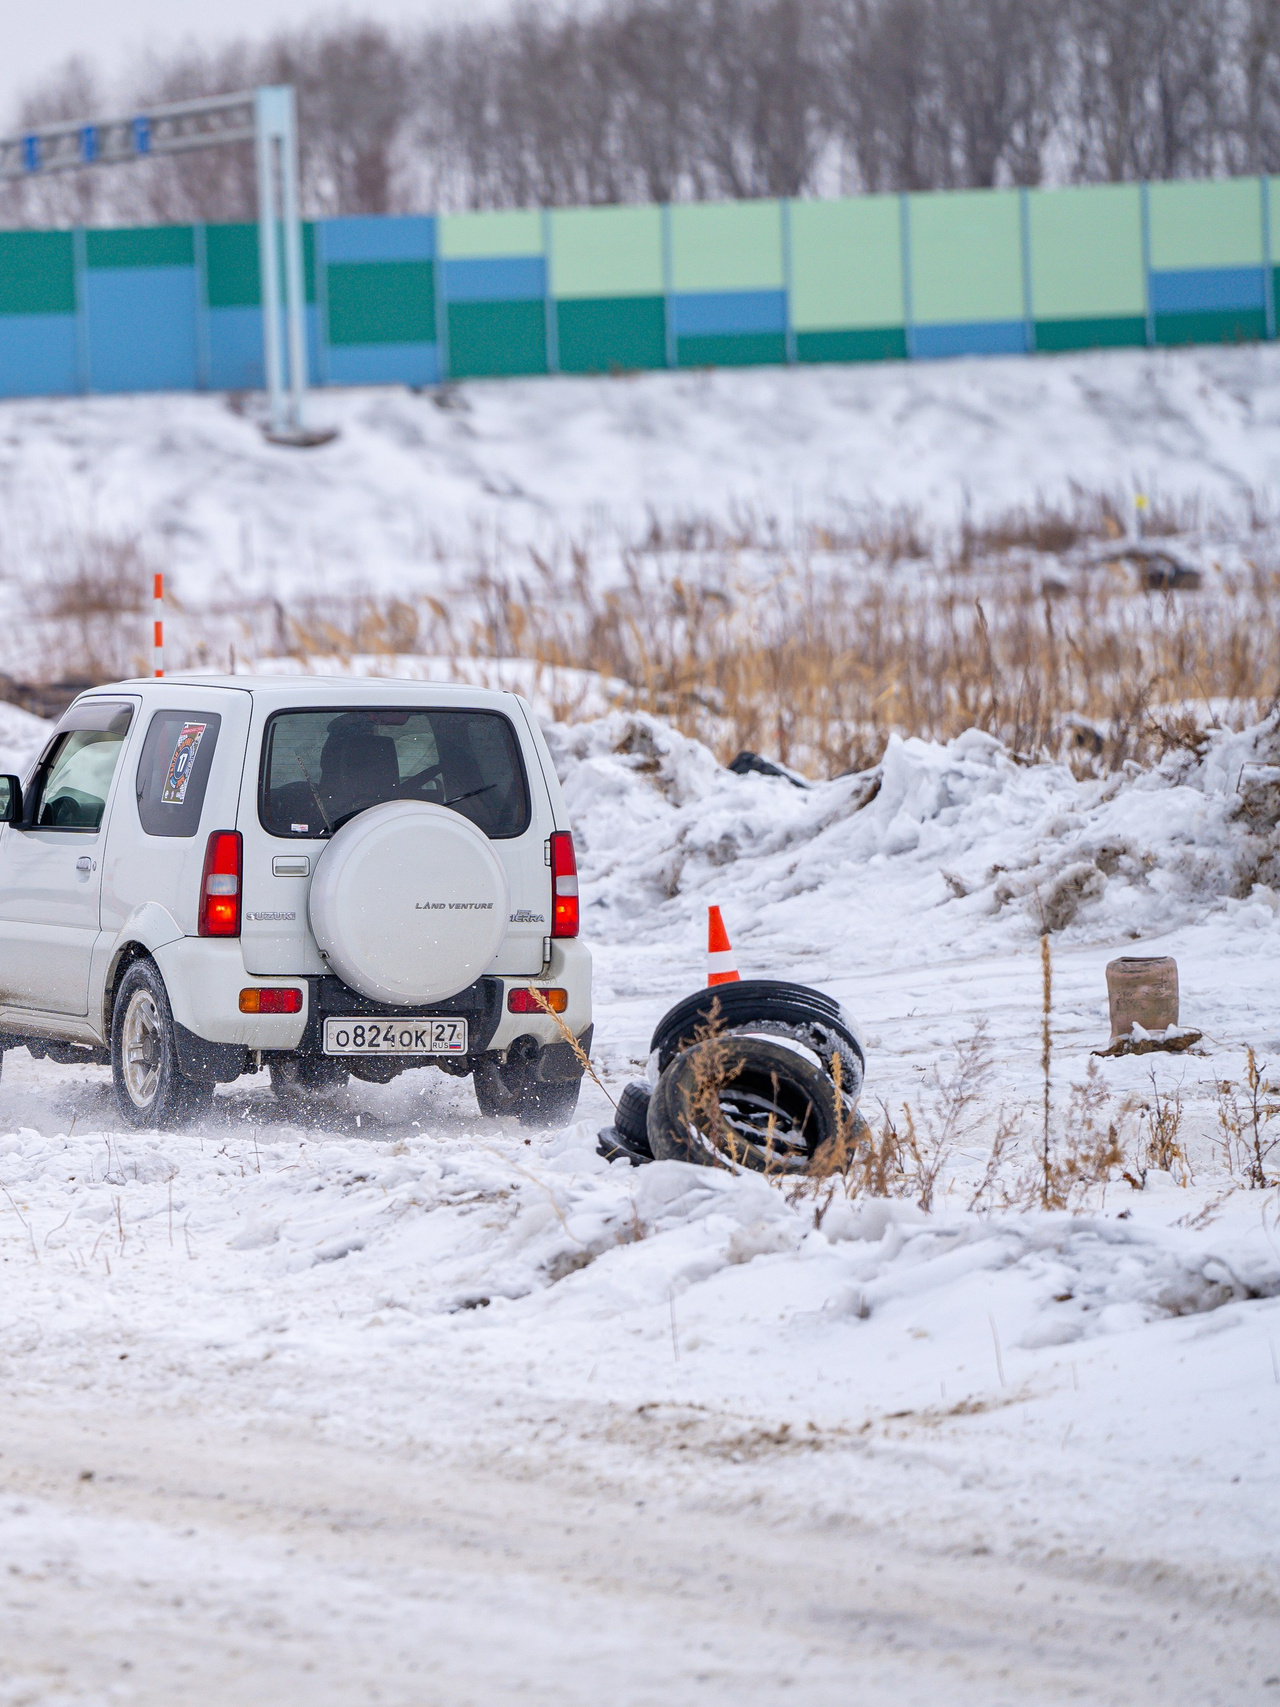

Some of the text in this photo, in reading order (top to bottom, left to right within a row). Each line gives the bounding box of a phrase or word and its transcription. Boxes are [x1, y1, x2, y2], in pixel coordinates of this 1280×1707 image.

[415, 902, 494, 910] LAND VENTURE
[246, 911, 296, 921] SUZUKI
[434, 1024, 457, 1042] 27
